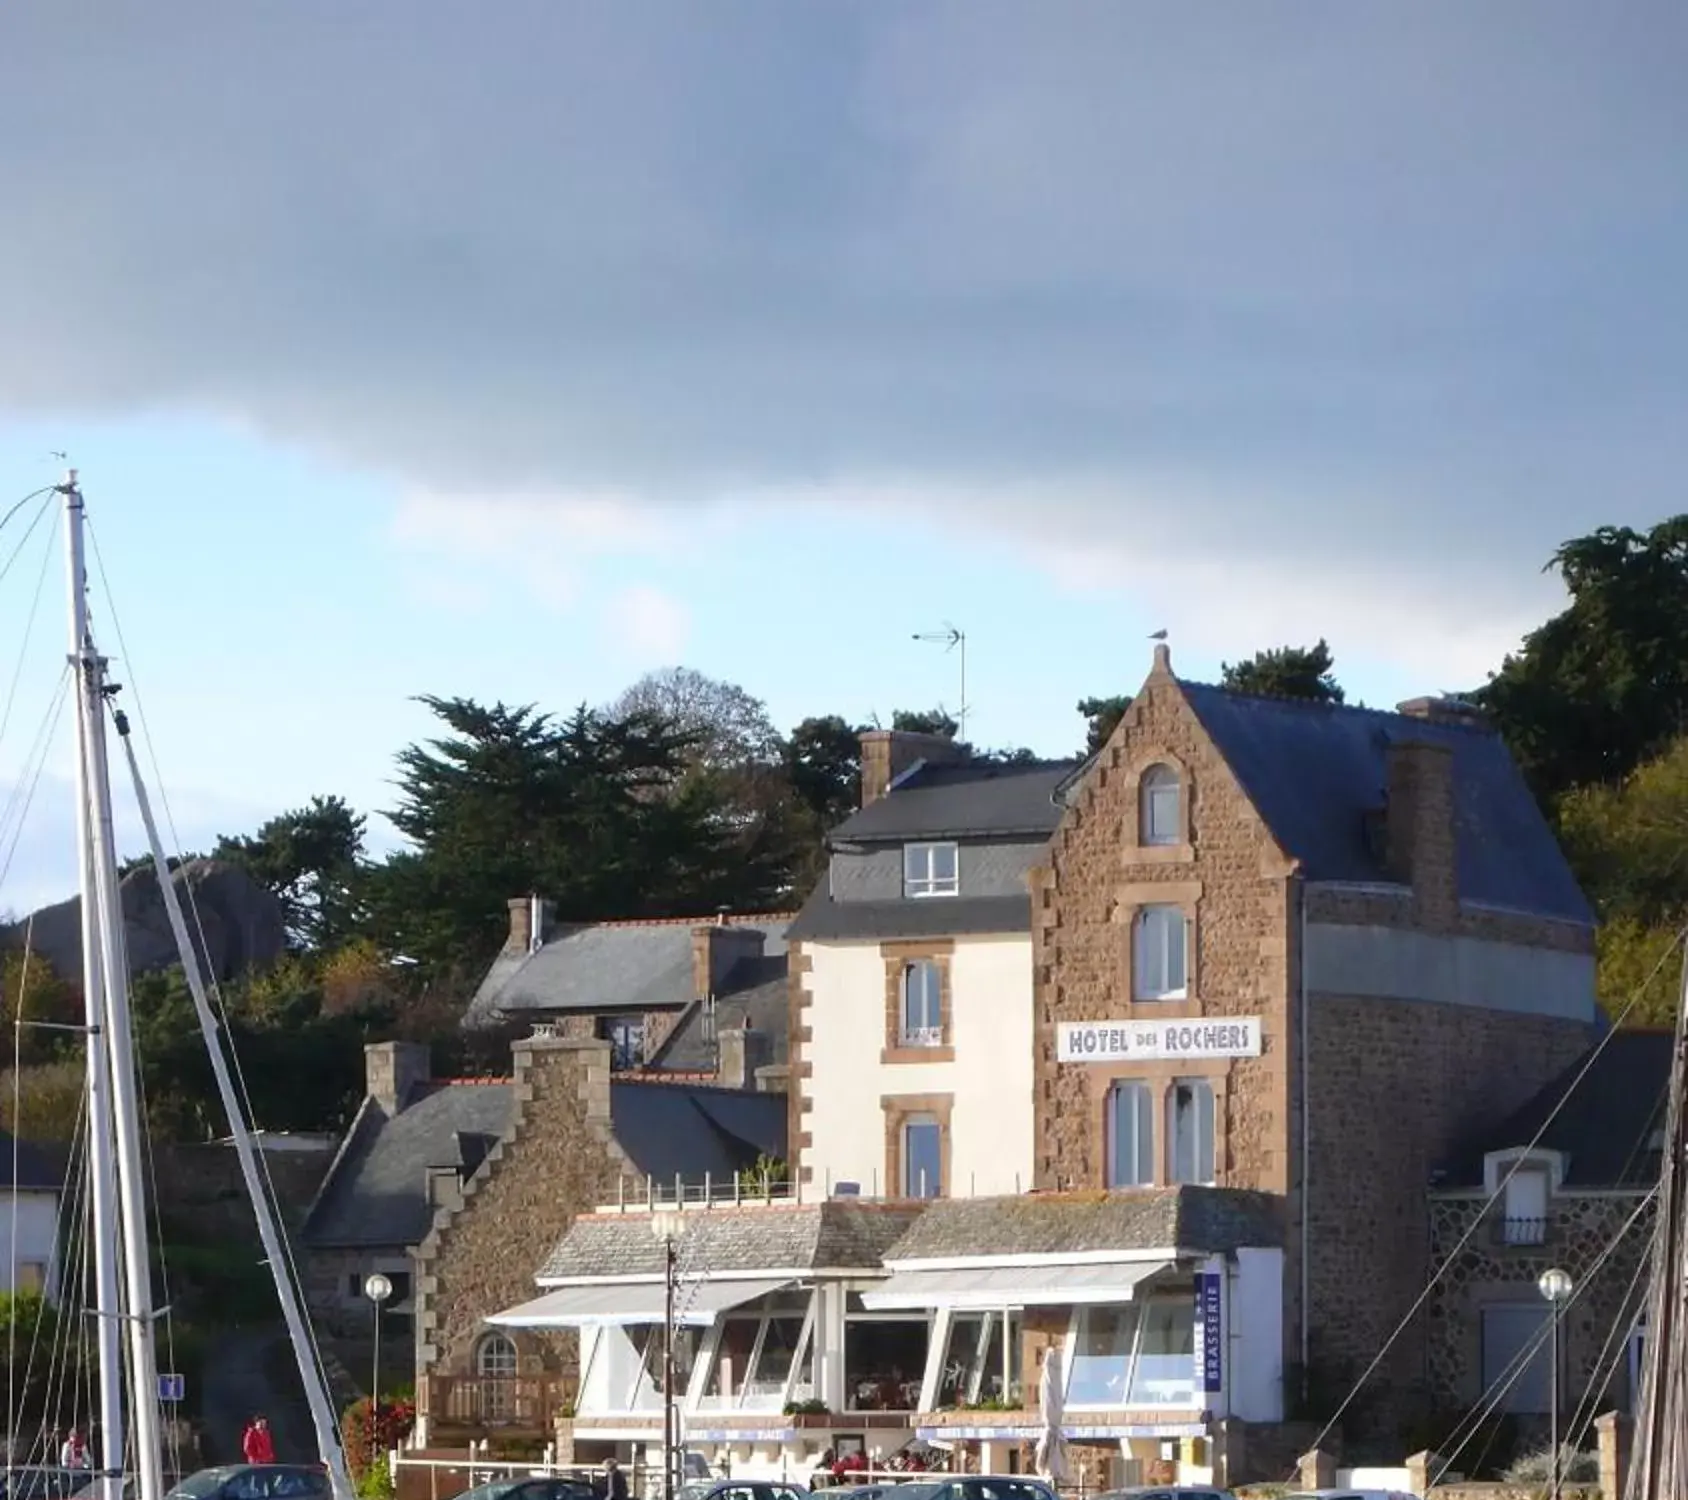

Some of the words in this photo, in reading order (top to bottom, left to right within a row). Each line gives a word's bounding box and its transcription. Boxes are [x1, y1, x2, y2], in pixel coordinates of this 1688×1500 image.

[1069, 1029, 1129, 1054] HOTEL
[1165, 1025, 1249, 1051] ROCHERS
[1207, 1286, 1219, 1379] BRASSERIE
